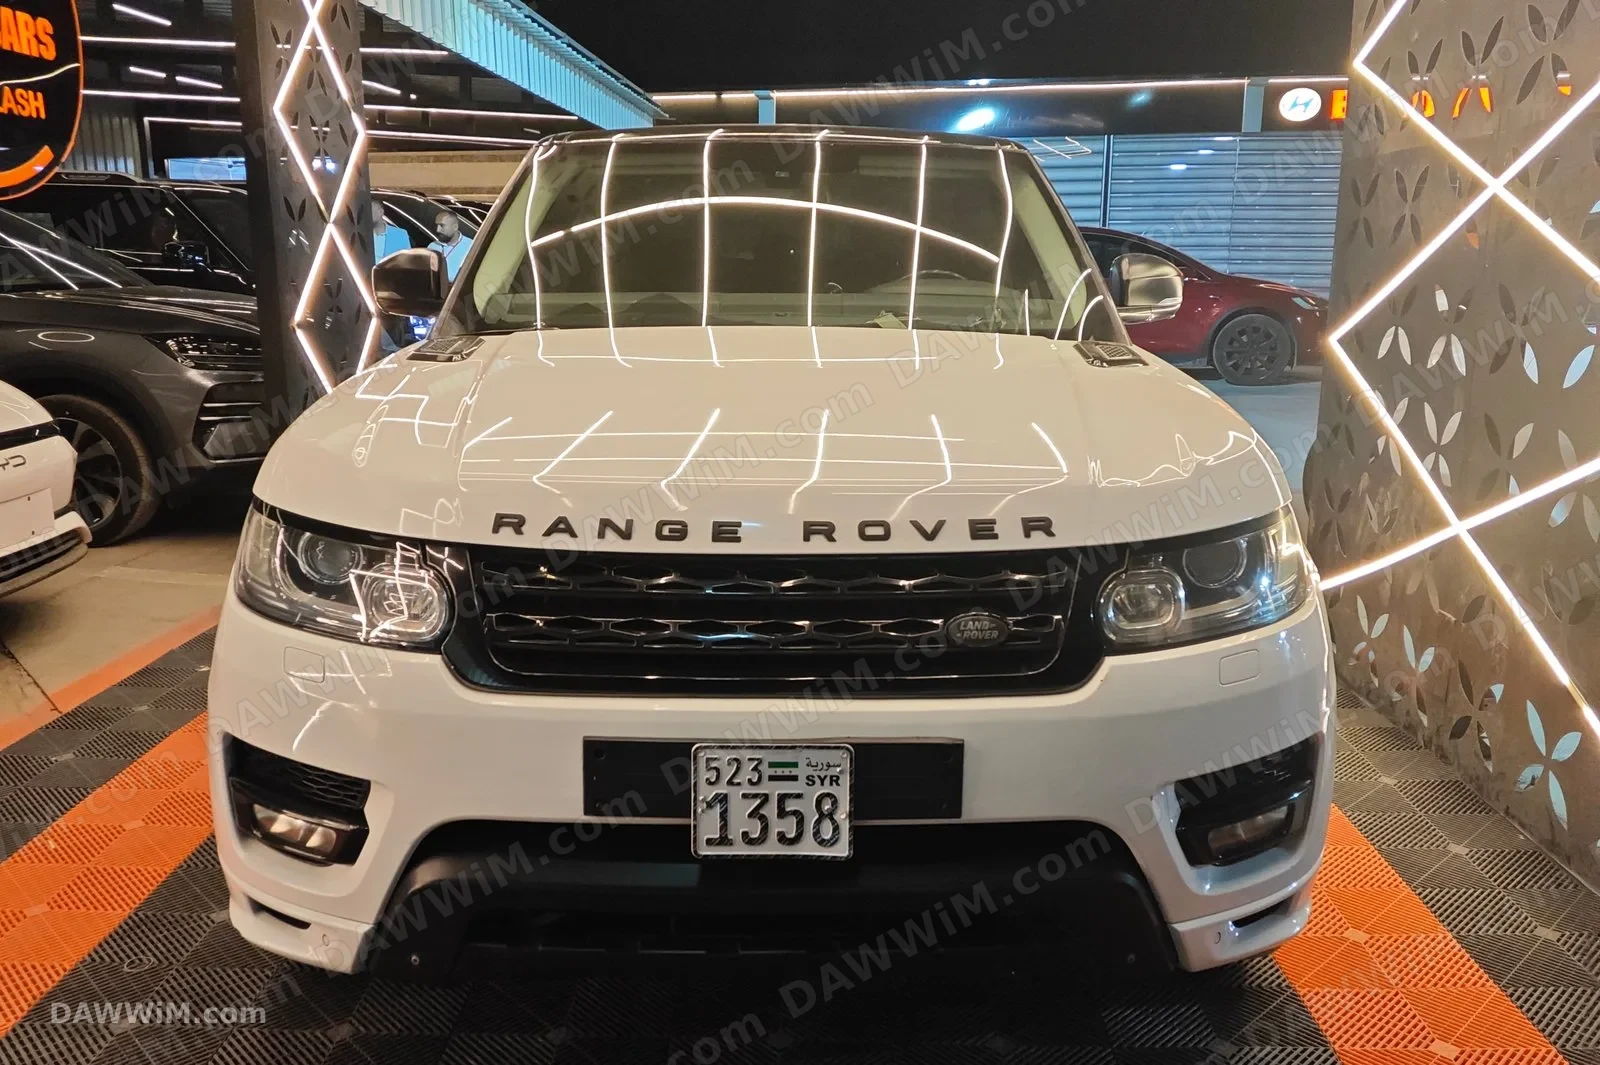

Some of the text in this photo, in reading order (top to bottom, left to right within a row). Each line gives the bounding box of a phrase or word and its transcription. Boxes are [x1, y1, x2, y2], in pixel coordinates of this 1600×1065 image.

[0, 86, 46, 119] ASH
[491, 512, 1056, 543] RANGE ROVER
[960, 621, 990, 631] LAND
[962, 630, 999, 640] ROVER
[705, 756, 763, 787] 523
[805, 757, 842, 773] سورية
[804, 775, 841, 787] SYR
[704, 791, 840, 848] 1358
